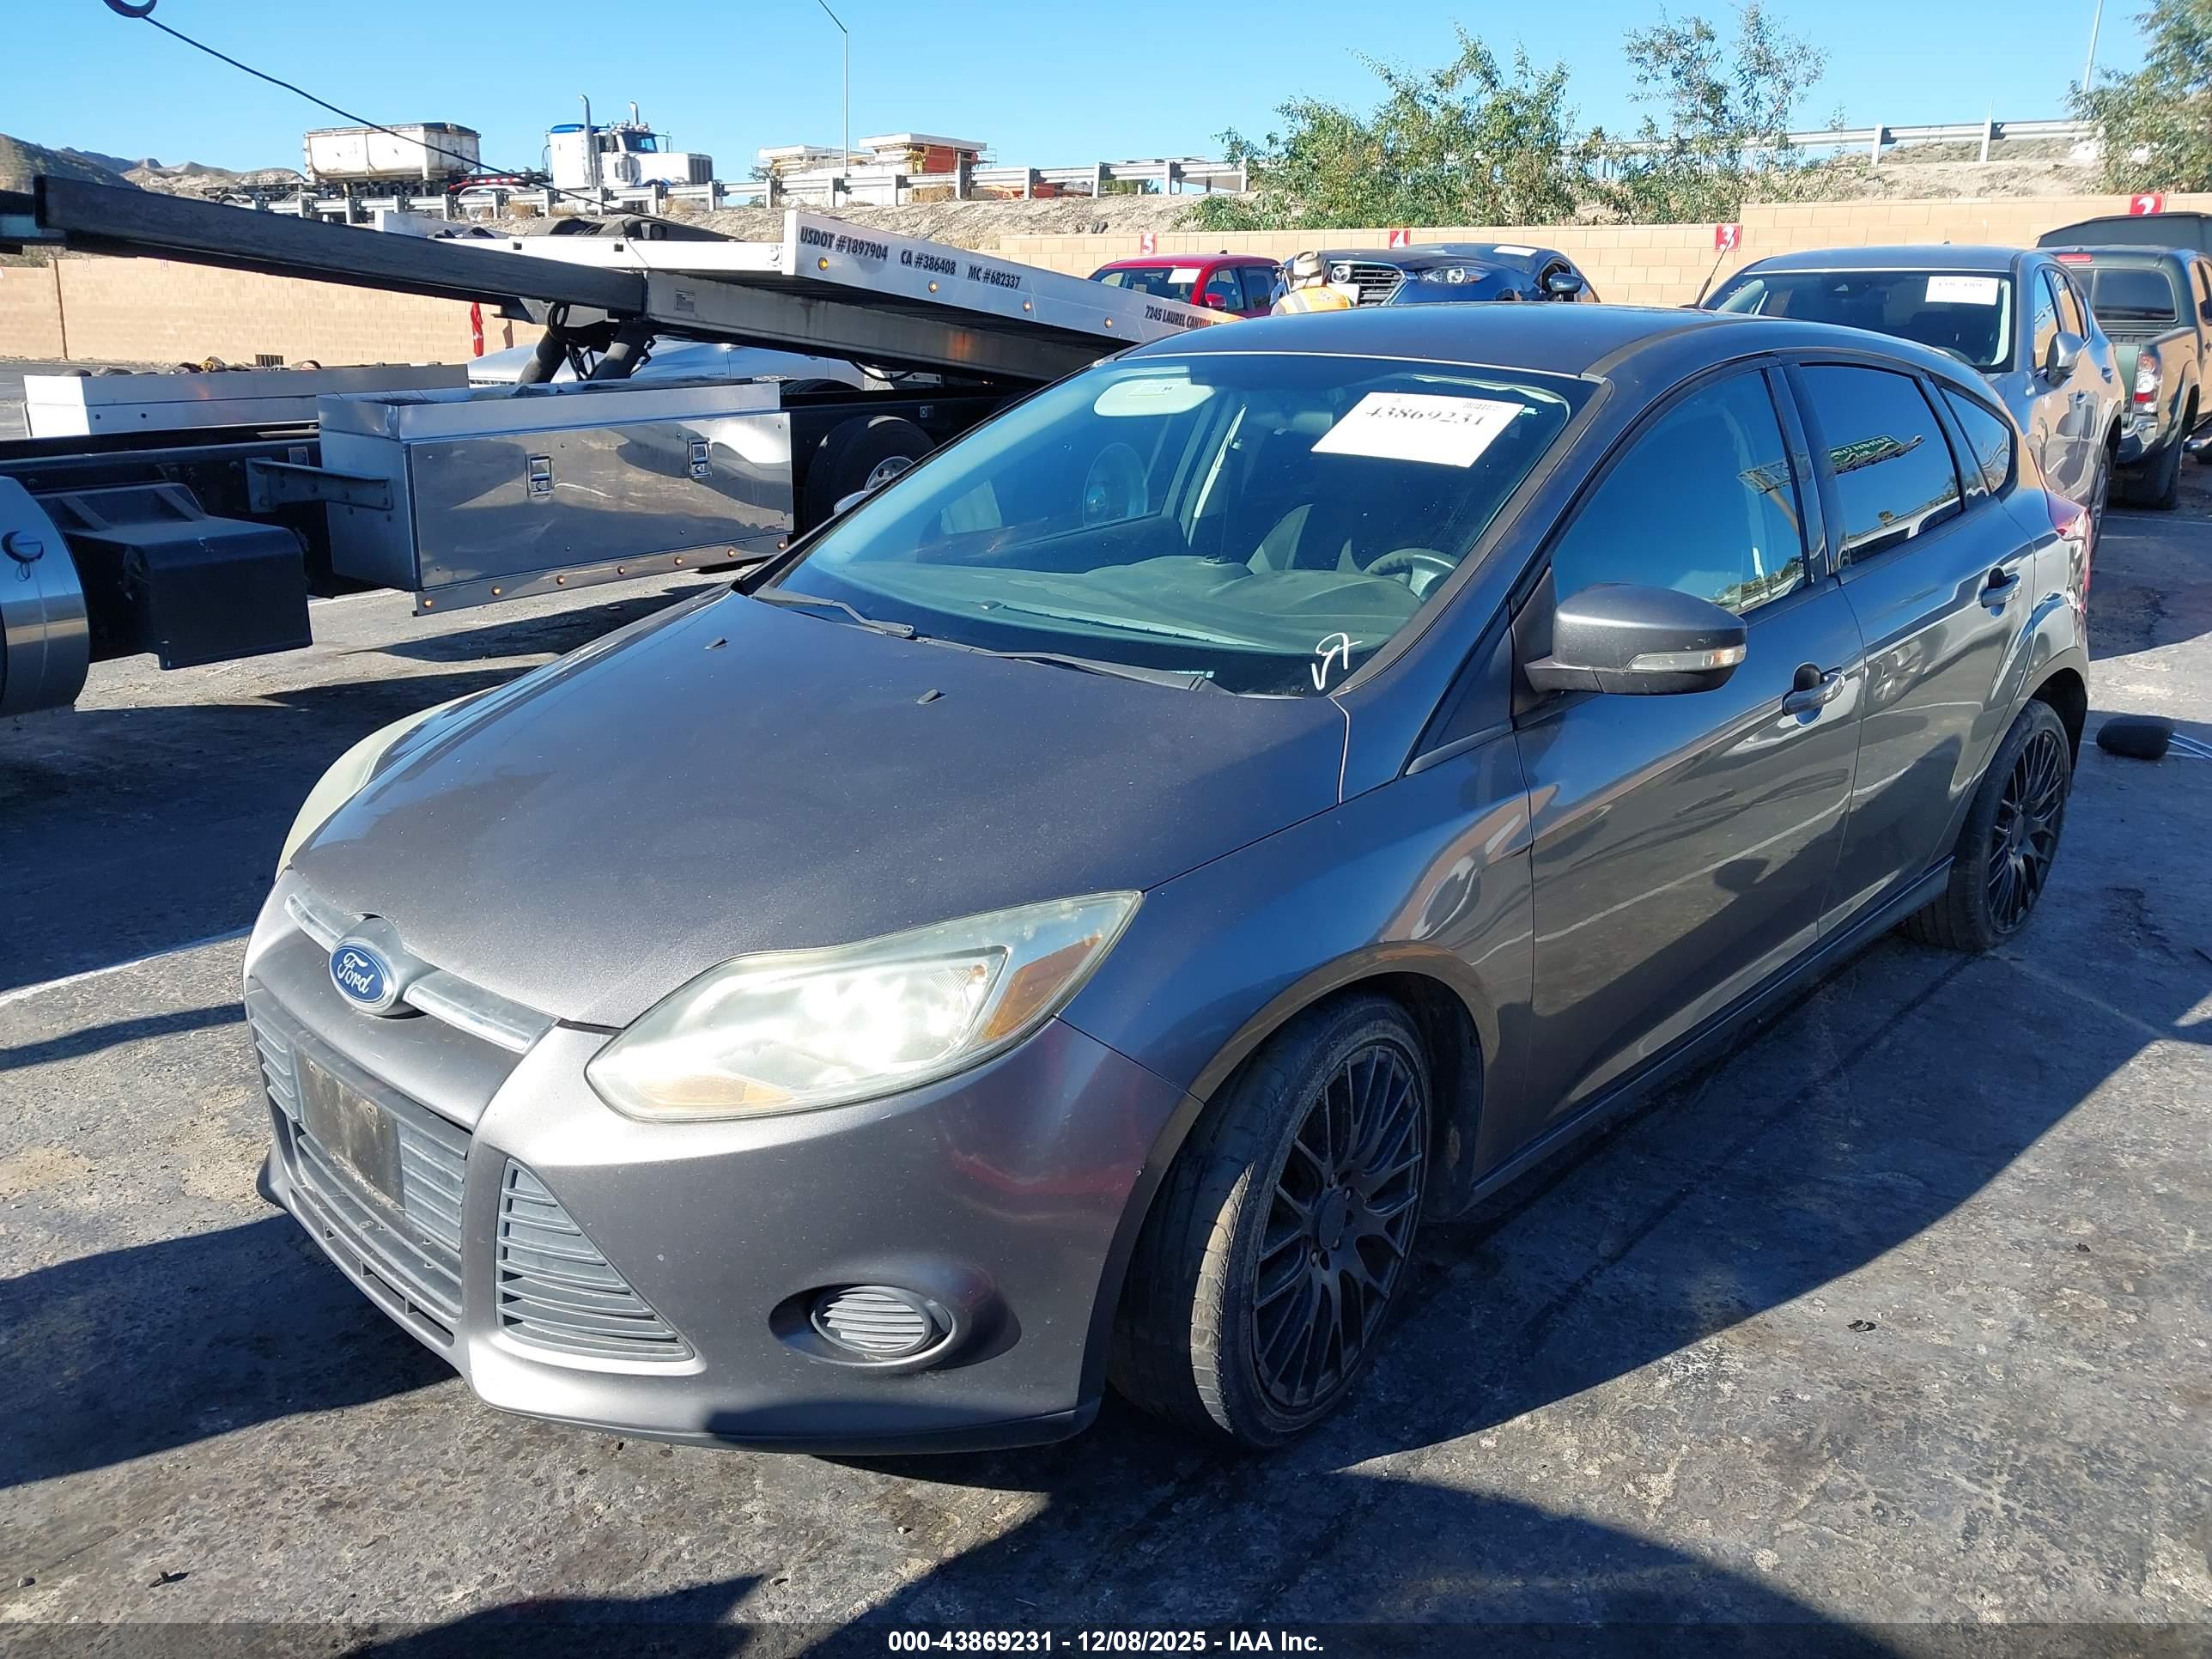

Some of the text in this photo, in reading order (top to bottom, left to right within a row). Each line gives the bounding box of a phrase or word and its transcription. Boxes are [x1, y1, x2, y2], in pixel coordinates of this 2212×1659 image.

[1143, 233, 1154, 255] 5
[1391, 230, 1406, 248] 4
[1719, 226, 1735, 250] 3
[800, 226, 1020, 289] USDOT #1897904 CA #386408 MC #682337
[1145, 305, 1163, 321] 7245
[1163, 308, 1186, 327] LAUREL
[1366, 406, 1486, 426] 43869231
[337, 951, 375, 994] Ford
